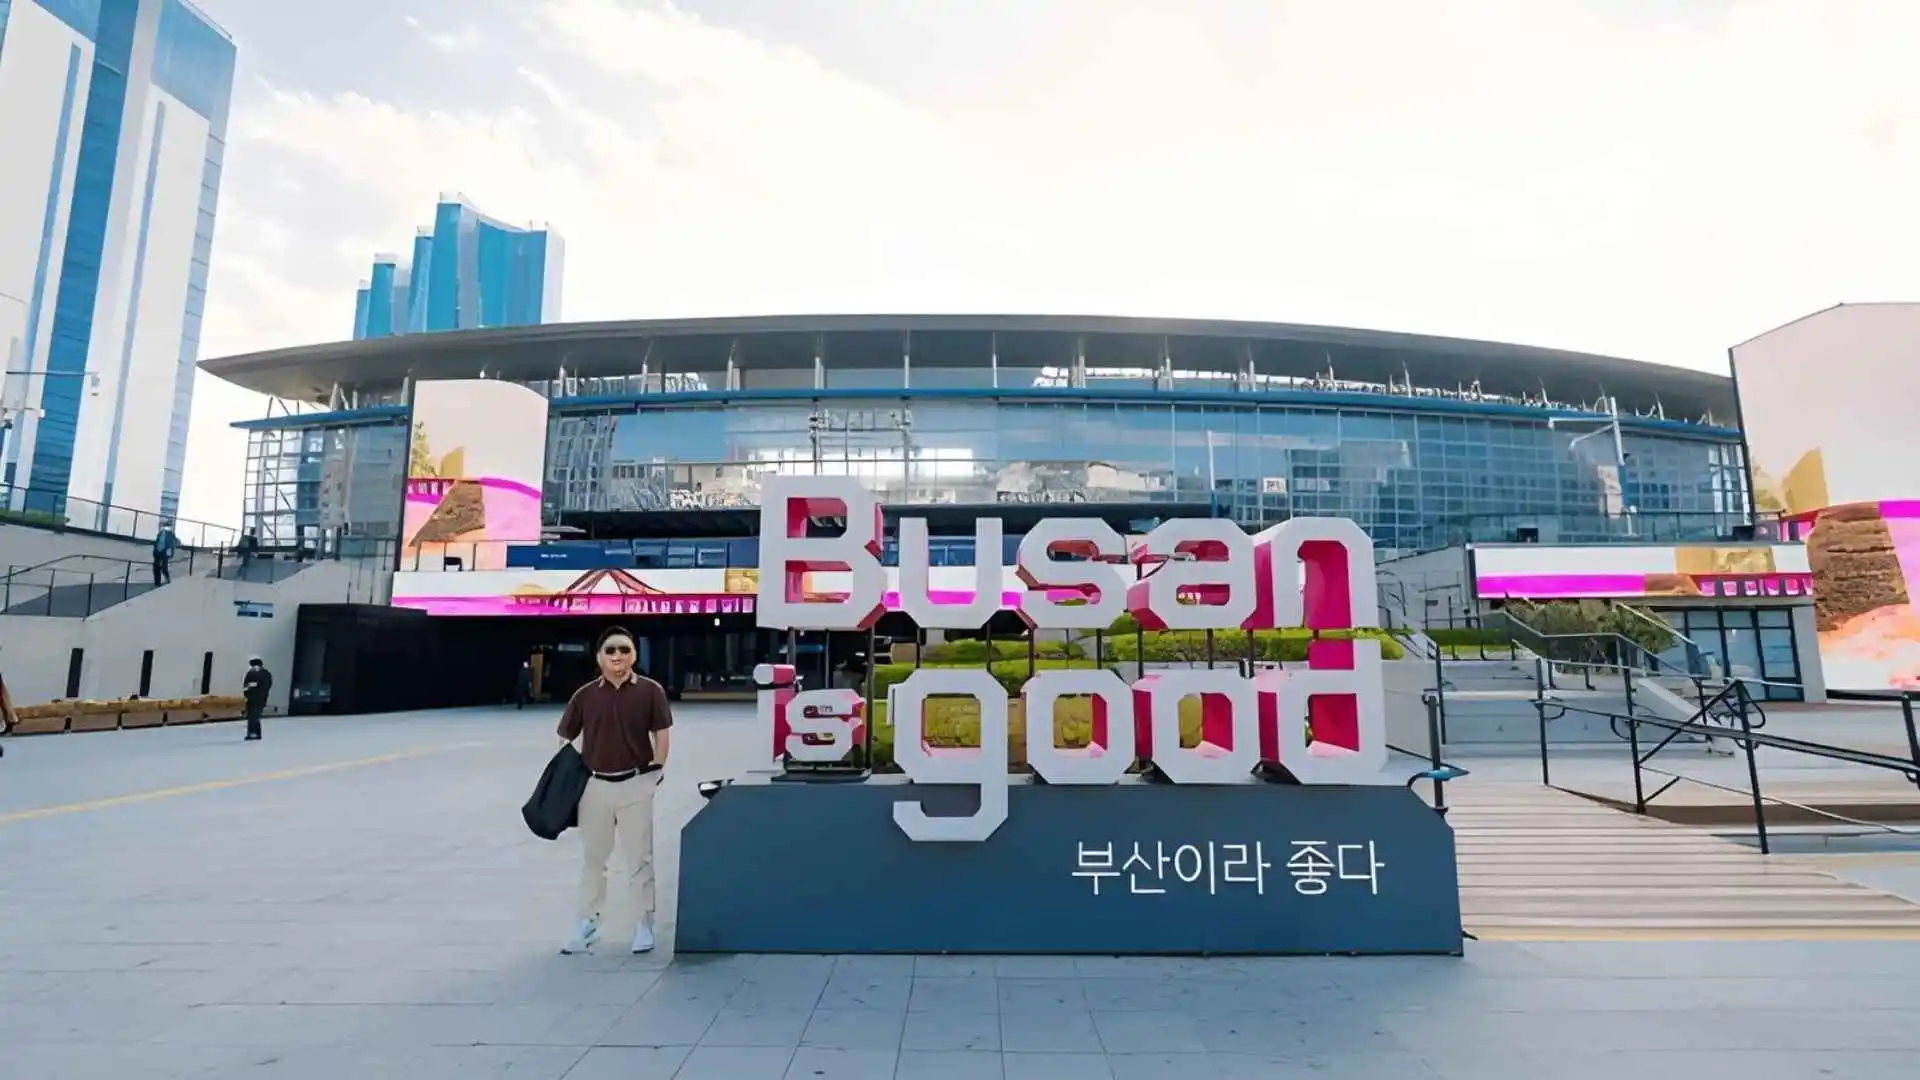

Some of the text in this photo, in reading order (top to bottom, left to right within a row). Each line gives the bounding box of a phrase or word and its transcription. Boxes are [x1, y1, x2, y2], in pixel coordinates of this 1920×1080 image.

[758, 475, 1376, 629] Busan
[753, 639, 1386, 841] is good
[1071, 840, 1385, 896] 부산이라 좋다
